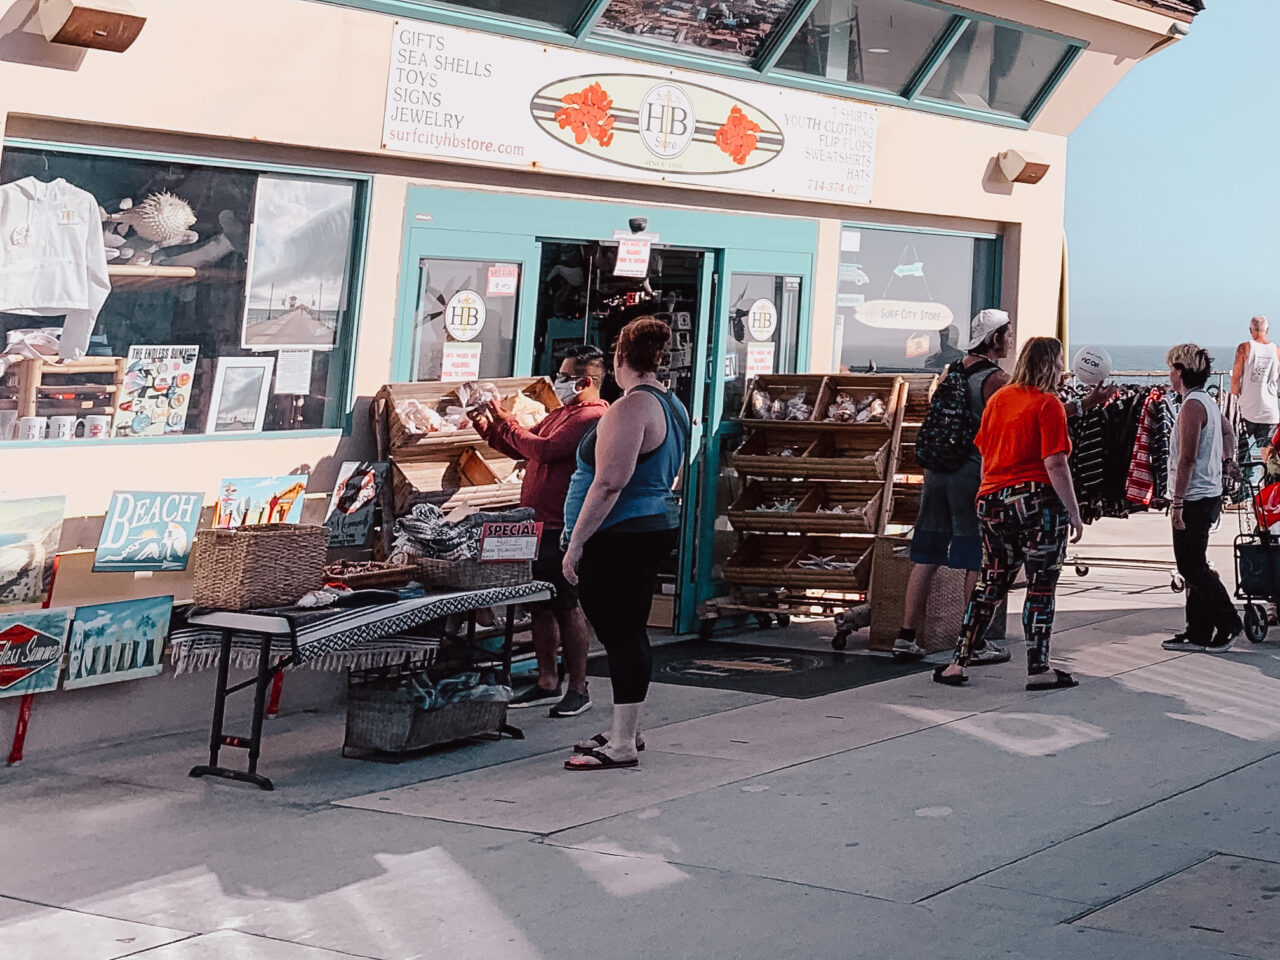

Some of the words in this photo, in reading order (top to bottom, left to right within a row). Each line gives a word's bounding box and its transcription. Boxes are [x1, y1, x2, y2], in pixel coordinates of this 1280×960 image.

[400, 29, 445, 52] GIFTS
[397, 48, 428, 67] SEA
[434, 54, 492, 78] SHELLS
[396, 67, 438, 88] TOYS
[393, 86, 442, 108] SIGNS
[391, 106, 465, 130] JEWELRY
[784, 113, 821, 130] YOUTH
[824, 120, 873, 138] CLOTHING
[388, 127, 524, 156] surfcityhbstore.com
[819, 134, 840, 148] FLIP
[805, 147, 872, 168] SWEATSHIRTS
[846, 167, 871, 180] HATS
[450, 306, 479, 326] HB
[752, 312, 772, 328] HB
[920, 310, 941, 321] STORE
[132, 348, 143, 359] THE
[144, 348, 169, 359] ENDLESS
[100, 493, 198, 549] BEACH
[487, 524, 537, 536] SPECIAL
